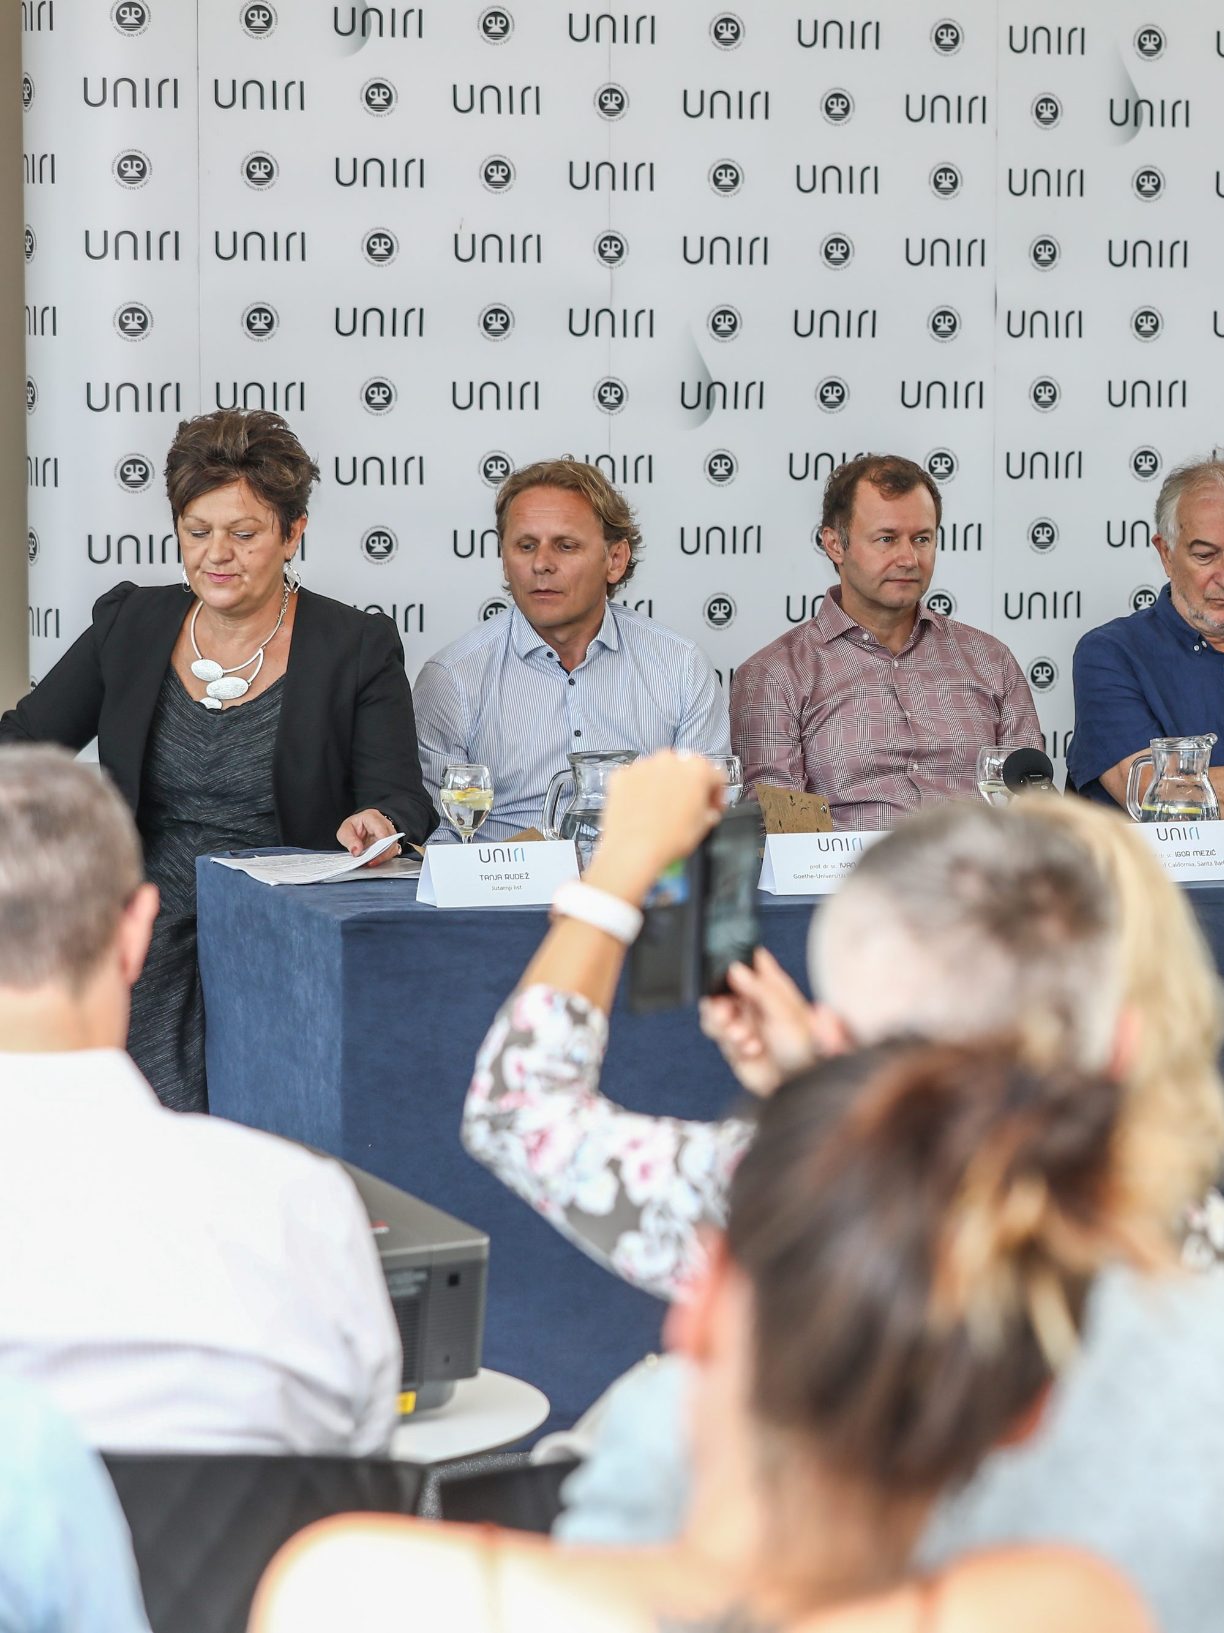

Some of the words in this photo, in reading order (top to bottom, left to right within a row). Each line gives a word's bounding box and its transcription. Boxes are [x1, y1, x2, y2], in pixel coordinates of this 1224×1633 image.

[1174, 850, 1191, 858] IGOR
[480, 874, 503, 882] TANJA
[504, 872, 530, 881] RUDEŽ
